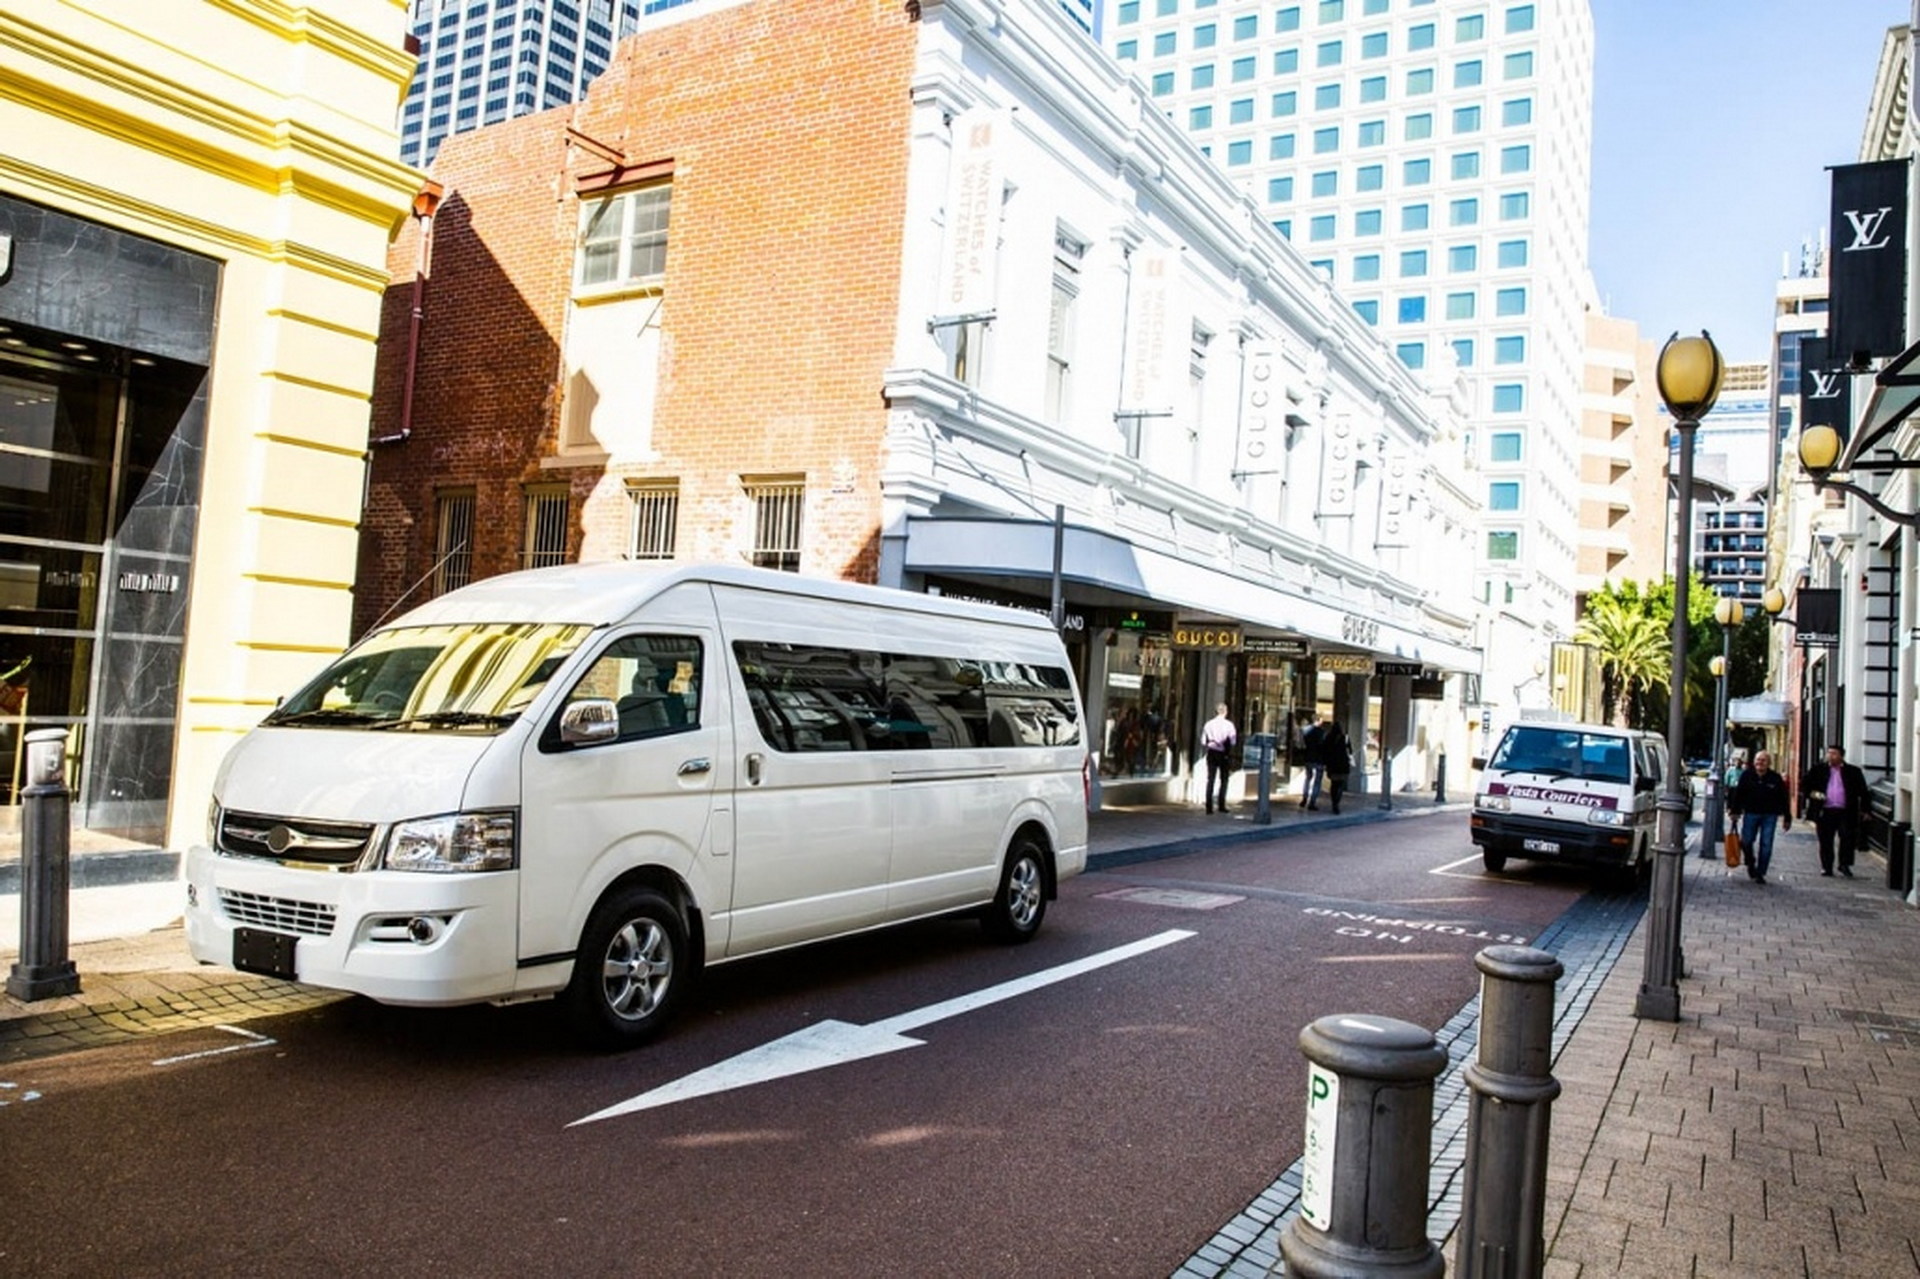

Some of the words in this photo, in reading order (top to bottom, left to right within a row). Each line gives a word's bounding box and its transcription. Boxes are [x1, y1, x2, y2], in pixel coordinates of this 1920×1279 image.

[971, 159, 993, 250] WATCHES
[952, 163, 976, 303] SWITZERLAND
[969, 256, 982, 275] of
[1247, 353, 1272, 459] GUCCI
[1330, 413, 1351, 503] GUCCI
[1387, 456, 1406, 535] GUCCI
[1176, 630, 1238, 646] GUCCI
[1321, 656, 1371, 670] GUCCI
[1505, 784, 1538, 798] Fasta
[1540, 790, 1603, 807] Couriers
[1335, 926, 1414, 943] NO
[1311, 1074, 1330, 1109] P
